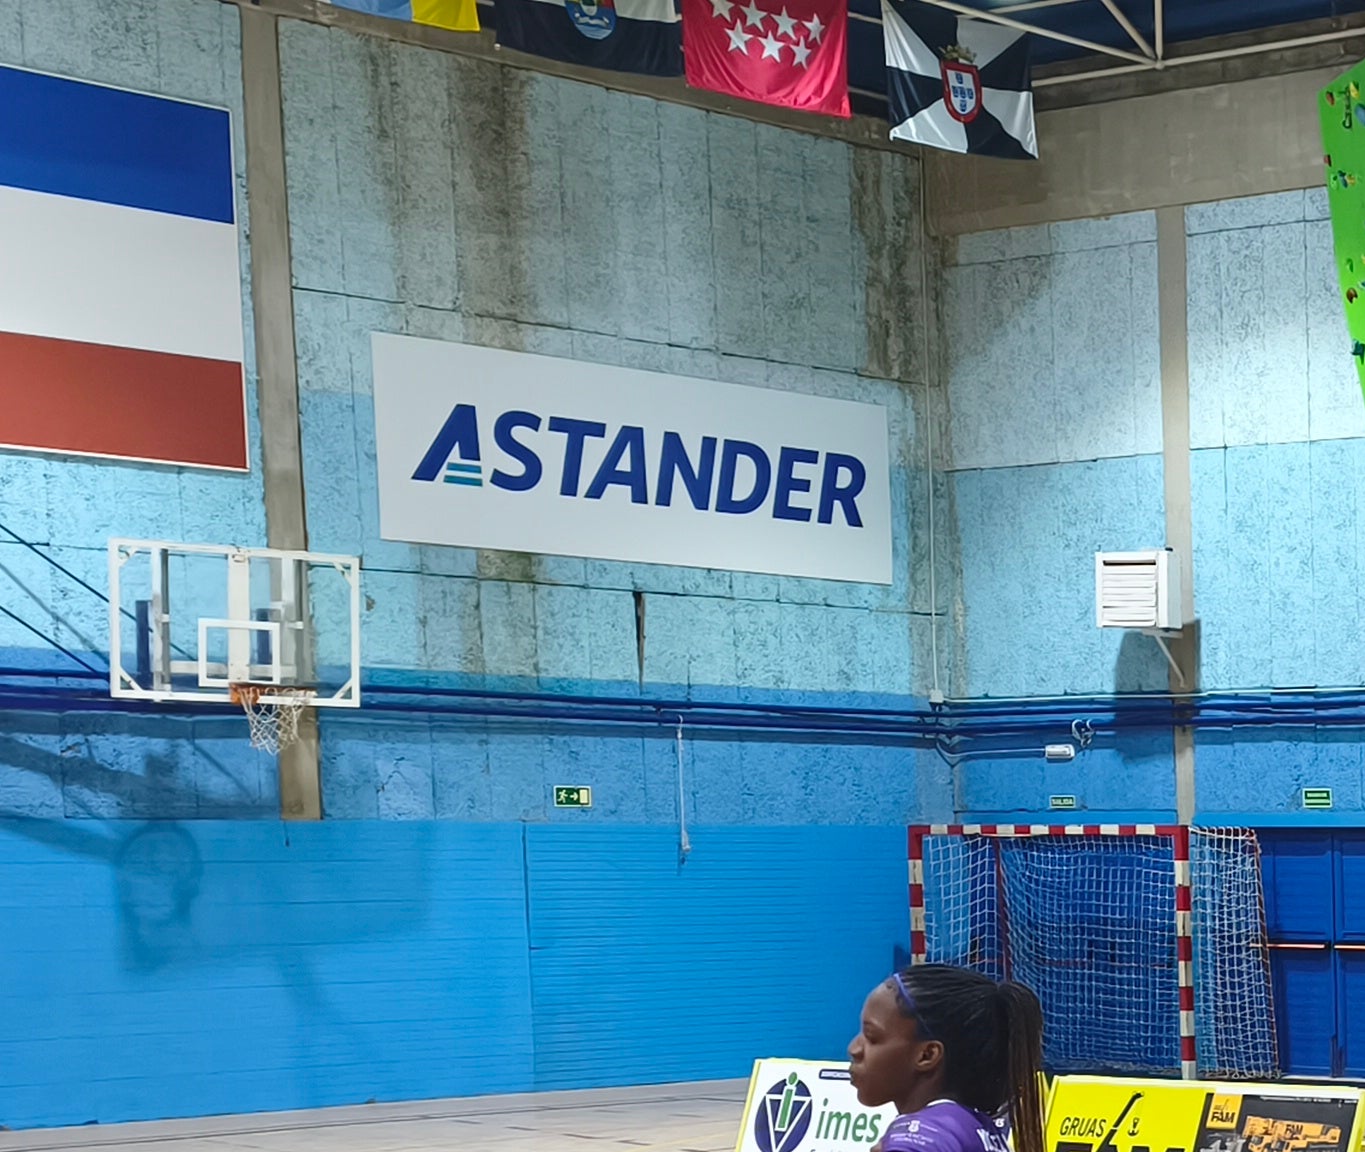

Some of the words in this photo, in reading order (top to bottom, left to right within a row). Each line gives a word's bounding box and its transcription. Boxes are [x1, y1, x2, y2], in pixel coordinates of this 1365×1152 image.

[410, 403, 867, 528] ASTANDER
[813, 1097, 881, 1143] imes
[1058, 1116, 1107, 1138] GRUAS
[1210, 1111, 1236, 1123] FAM
